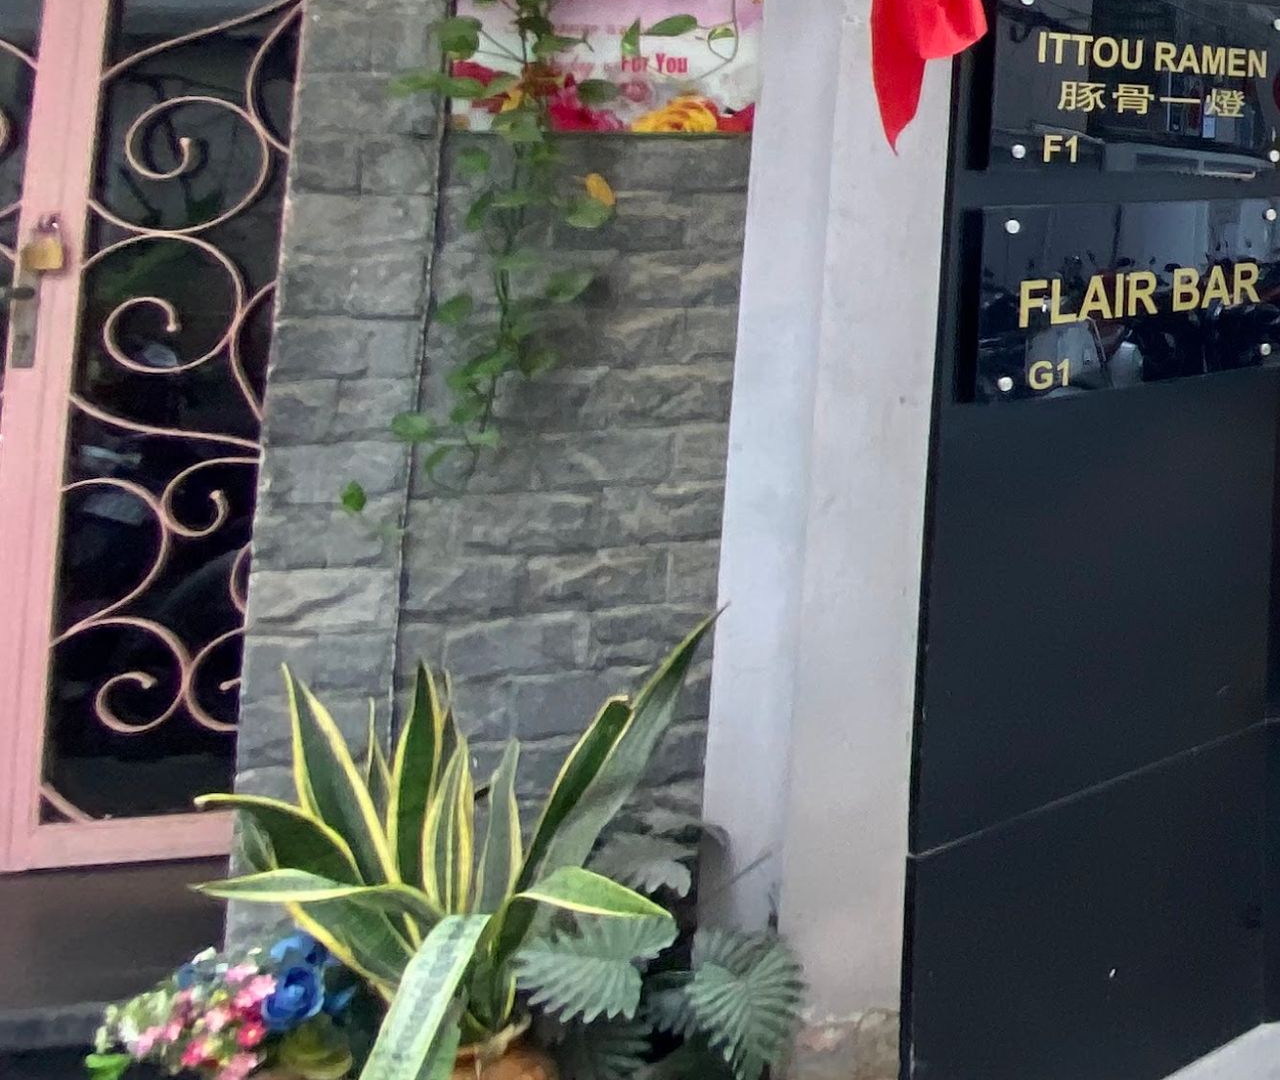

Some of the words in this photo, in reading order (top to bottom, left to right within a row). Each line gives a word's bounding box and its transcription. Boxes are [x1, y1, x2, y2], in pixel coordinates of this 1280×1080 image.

[655, 53, 688, 73] You
[1037, 31, 1144, 70] ITTOU
[1155, 41, 1269, 79] RAMEN
[1057, 81, 1245, 118] 豚骨一燈
[1043, 135, 1078, 163] F1
[1018, 271, 1159, 329] FLAIR
[1173, 262, 1261, 313] BAR
[1028, 358, 1071, 390] G1
